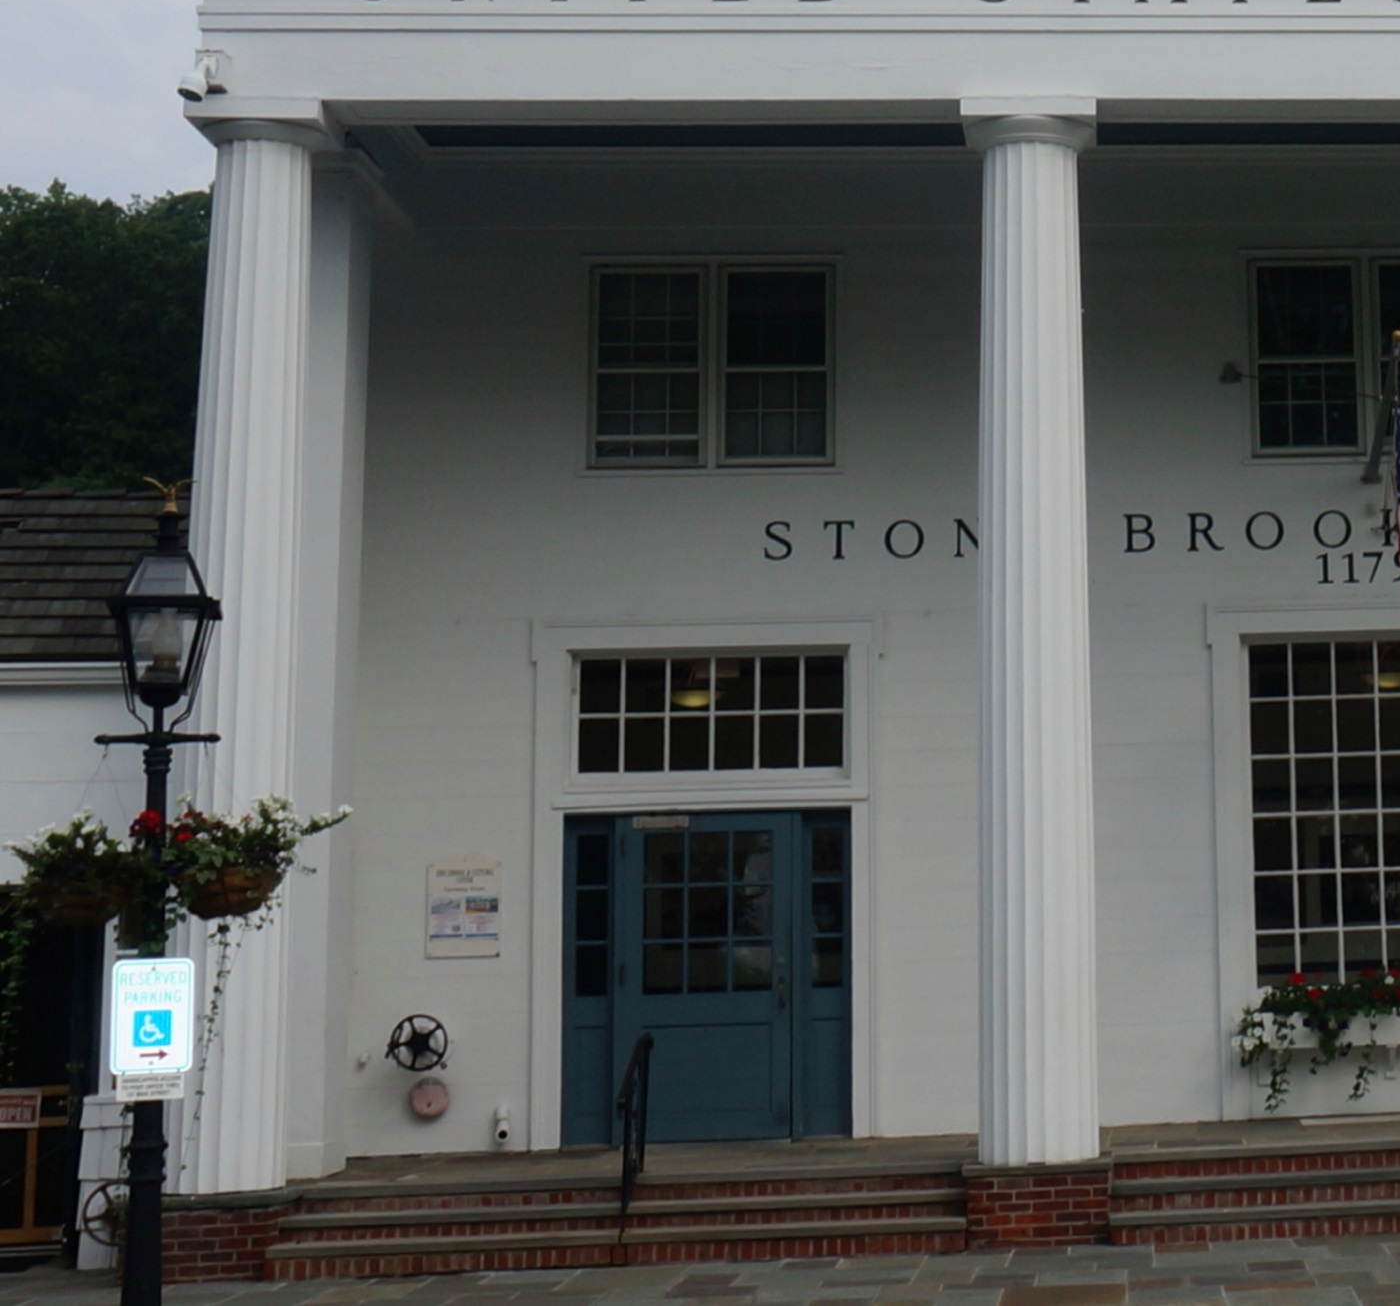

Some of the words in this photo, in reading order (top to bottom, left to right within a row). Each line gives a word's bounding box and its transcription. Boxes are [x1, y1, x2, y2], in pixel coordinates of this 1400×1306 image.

[763, 517, 979, 561] STON
[121, 971, 187, 986] RESERVED
[125, 991, 182, 1004] PARKING
